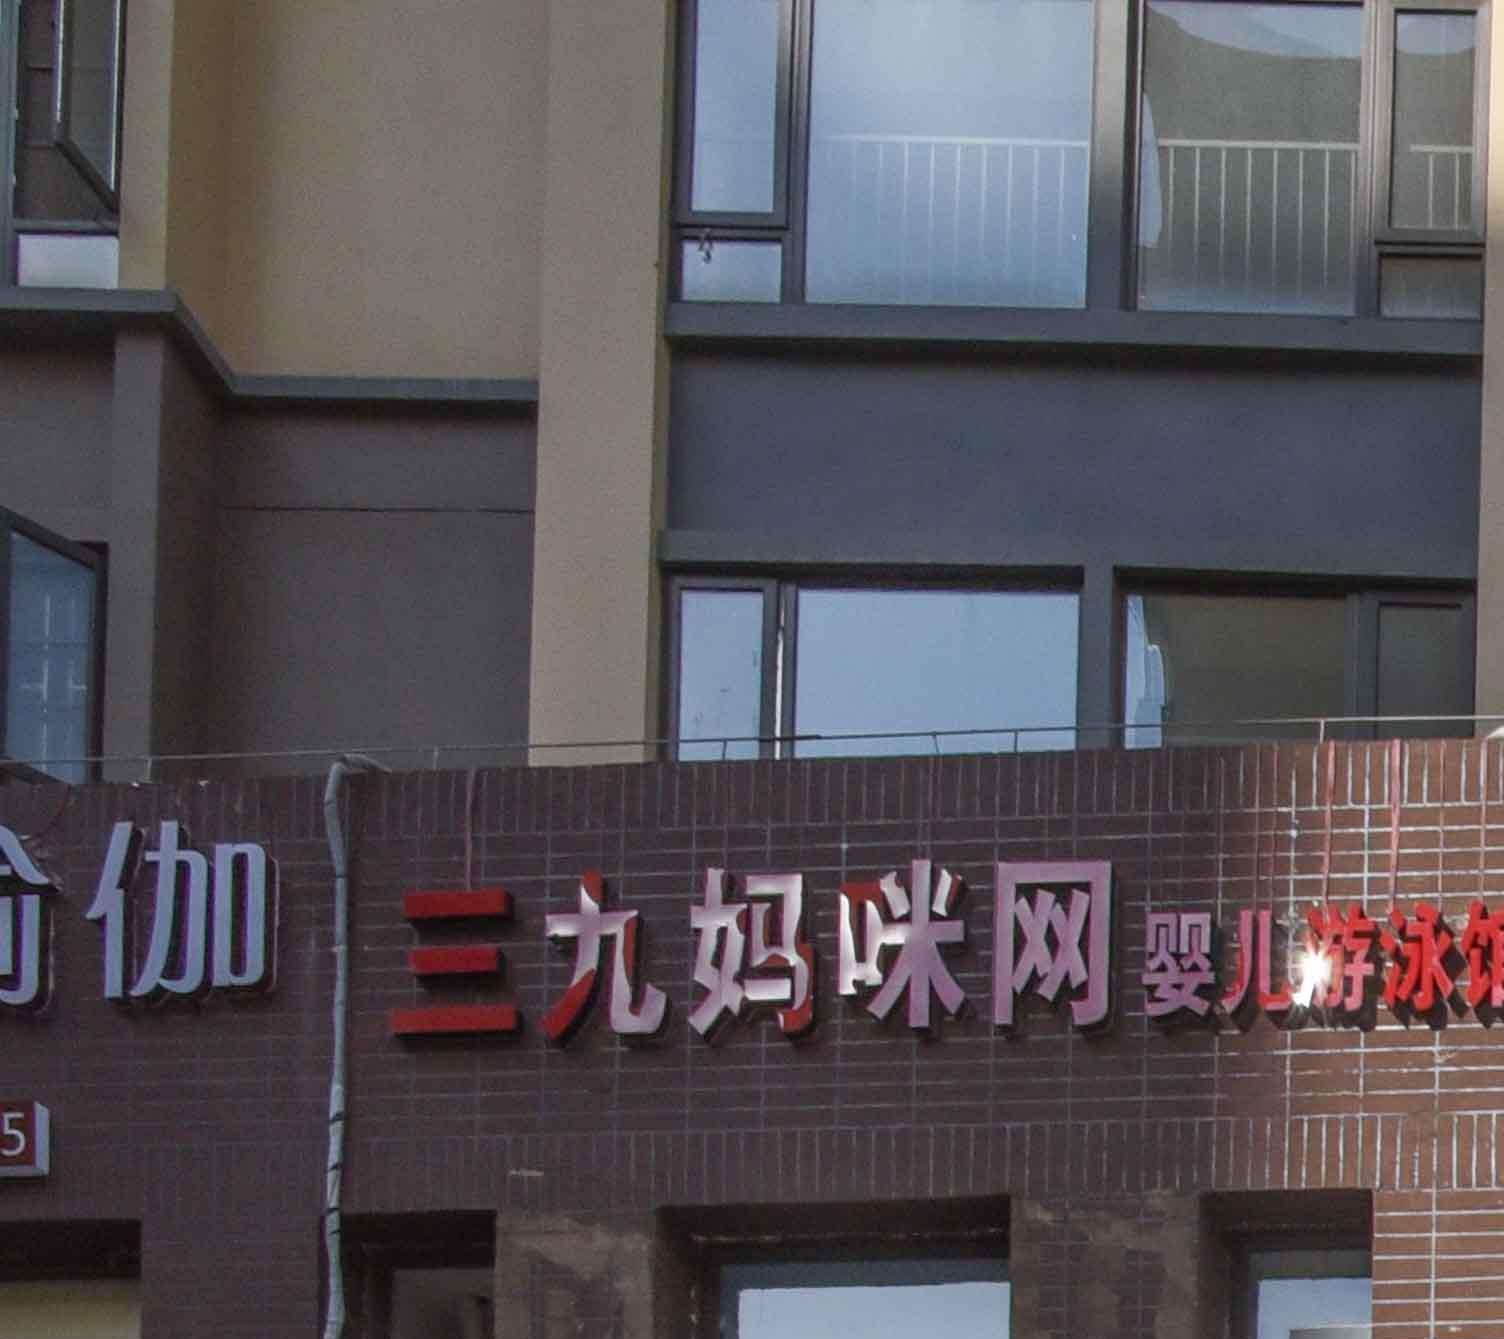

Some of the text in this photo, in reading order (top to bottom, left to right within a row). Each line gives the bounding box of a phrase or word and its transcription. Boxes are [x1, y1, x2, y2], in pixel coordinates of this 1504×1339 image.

[393, 860, 1114, 1038] 三九妈咪网
